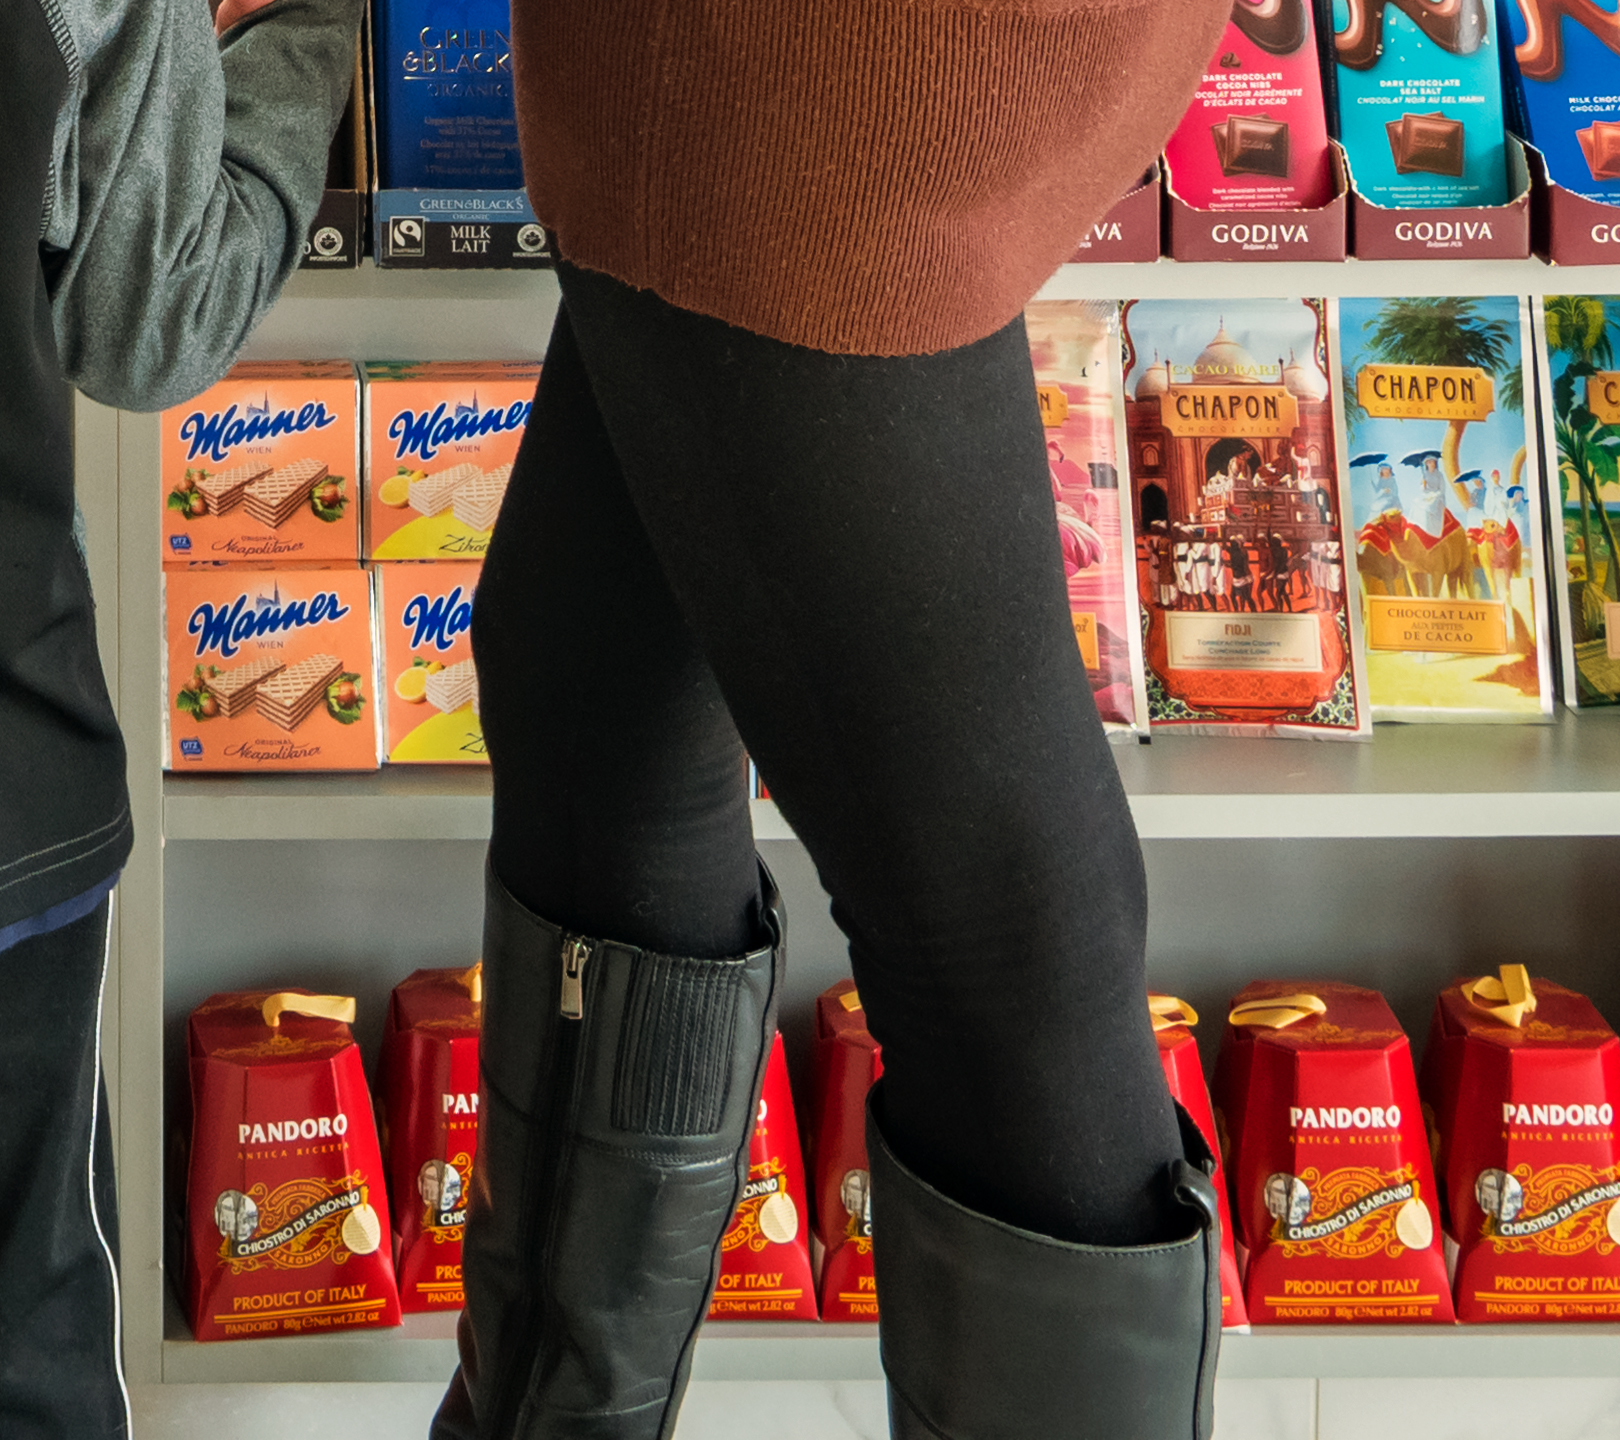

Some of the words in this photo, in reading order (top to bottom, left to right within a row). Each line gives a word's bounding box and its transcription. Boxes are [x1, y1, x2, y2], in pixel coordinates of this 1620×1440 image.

[1569, 96, 1591, 104] MILK
[450, 226, 491, 239] MILK
[1394, 221, 1491, 242] GODIVA
[452, 239, 490, 253] LAIT
[1373, 374, 1474, 402] CHAPON
[1175, 395, 1279, 421] CHAPON
[180, 400, 337, 461] Manner
[246, 446, 271, 454] WIEN
[1387, 607, 1452, 621] CHOCOLAT
[1456, 610, 1487, 621] LAIT
[1224, 623, 1252, 636] FIDJI
[1403, 629, 1420, 641] DE
[1423, 631, 1472, 643] CACAO
[238, 1114, 347, 1145] PANDORO
[237, 1228, 293, 1256] CHIOSTRO
[291, 1219, 307, 1233] DI
[305, 1191, 360, 1226] SARONNO
[233, 1292, 301, 1312] PRODUCT
[304, 1289, 326, 1304] OF
[328, 1285, 367, 1302] ITALY
